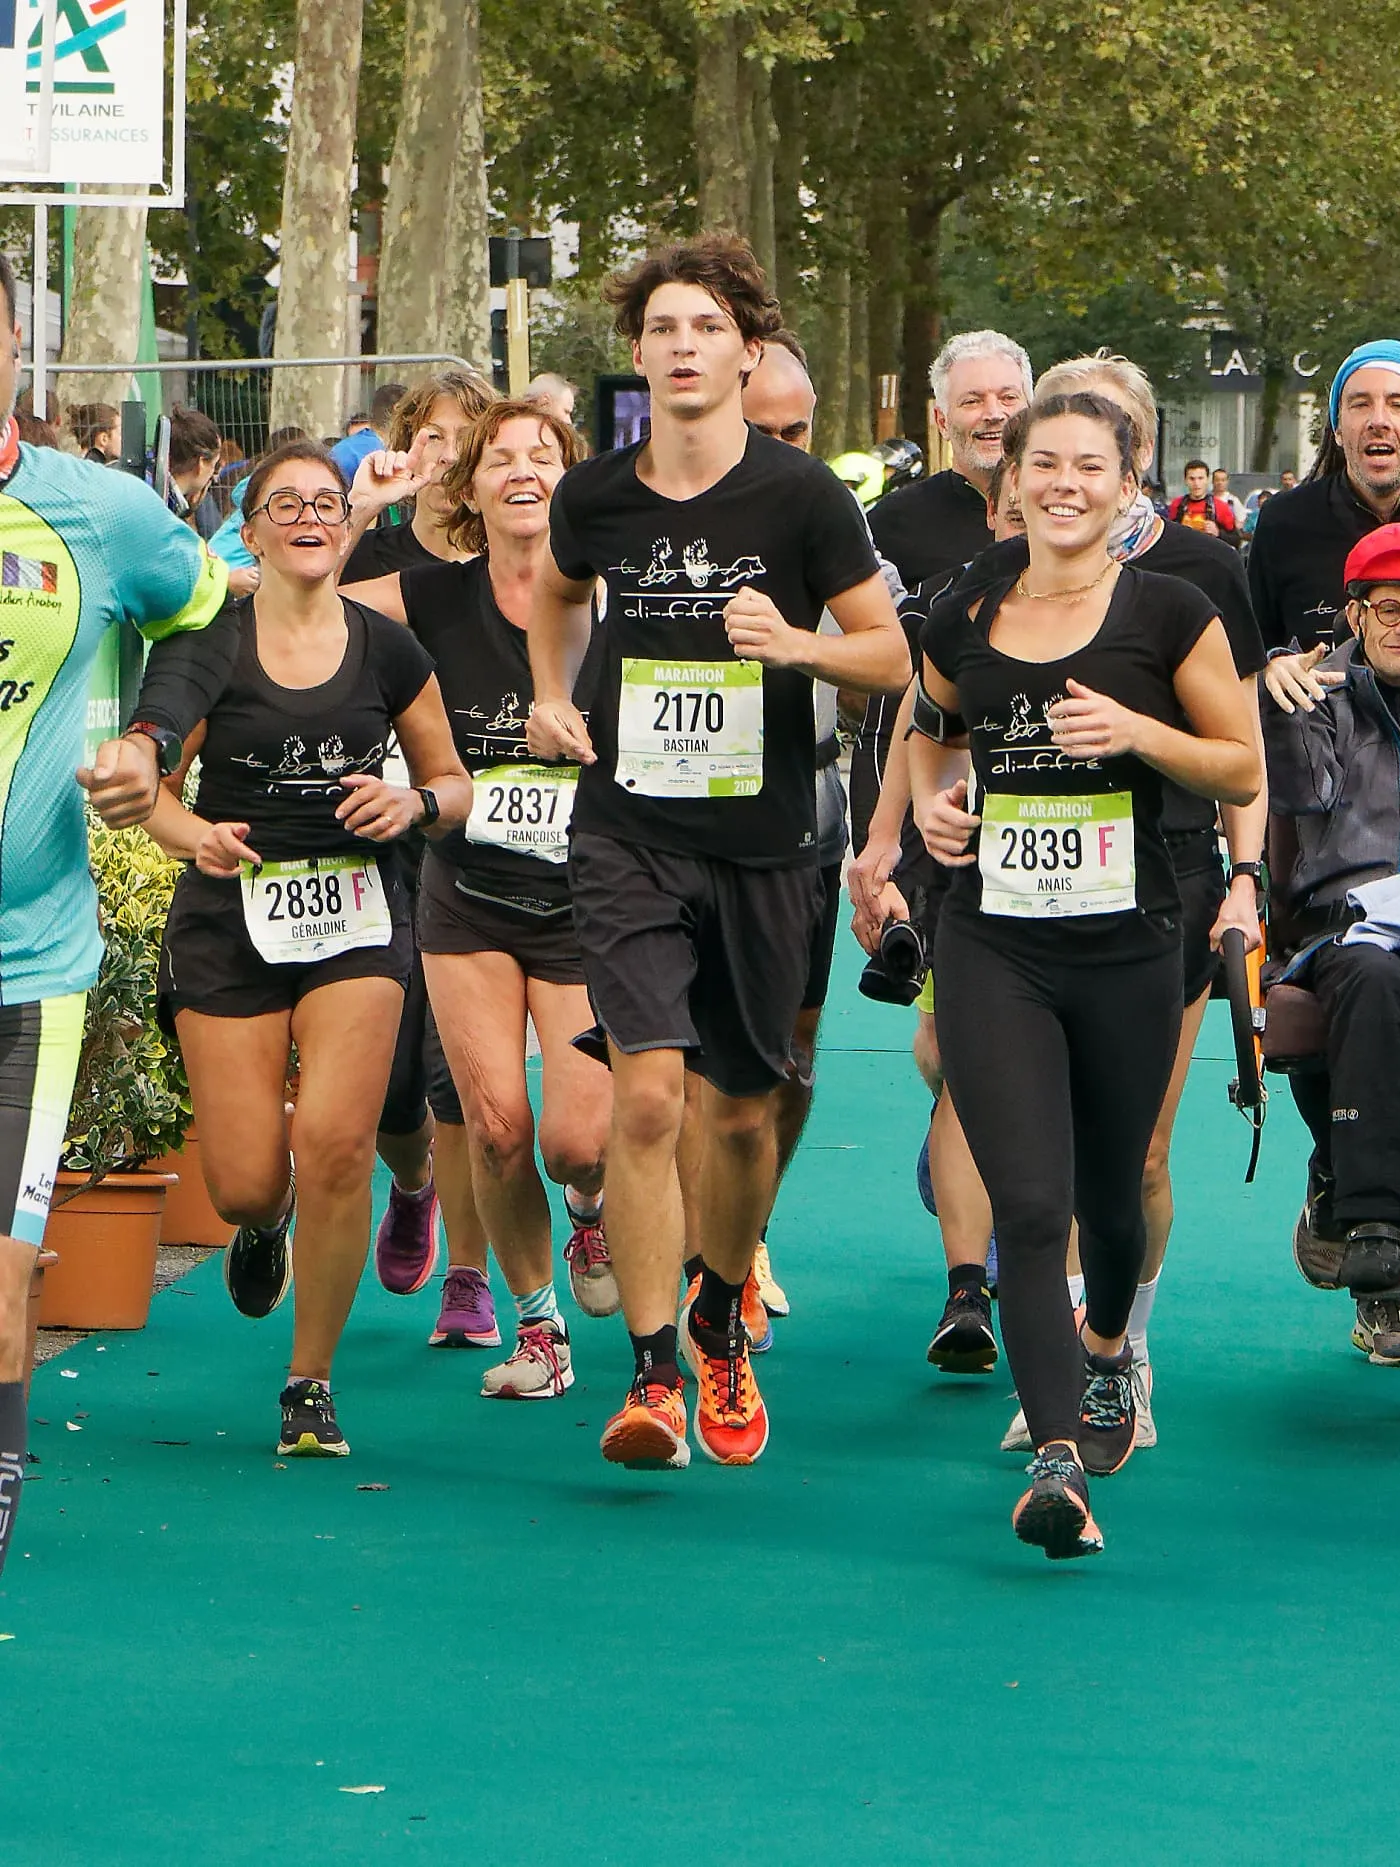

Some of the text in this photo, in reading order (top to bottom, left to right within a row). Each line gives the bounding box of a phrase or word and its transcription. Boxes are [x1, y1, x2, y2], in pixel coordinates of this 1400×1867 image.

[50, 129, 149, 142] SSURANCES
[653, 667, 725, 682] MARATHON
[653, 691, 725, 733] 2170
[663, 738, 709, 753] BASTIAN
[733, 780, 758, 794] 2170
[487, 787, 559, 825] 2837
[1018, 801, 1093, 817] MARATHON
[506, 830, 562, 845] FRANÇOISE
[1000, 826, 1115, 870] 2839 F
[1037, 877, 1073, 892] ANAIS
[265, 872, 366, 921] 2838 F
[291, 920, 348, 940] GÉRALDINE
